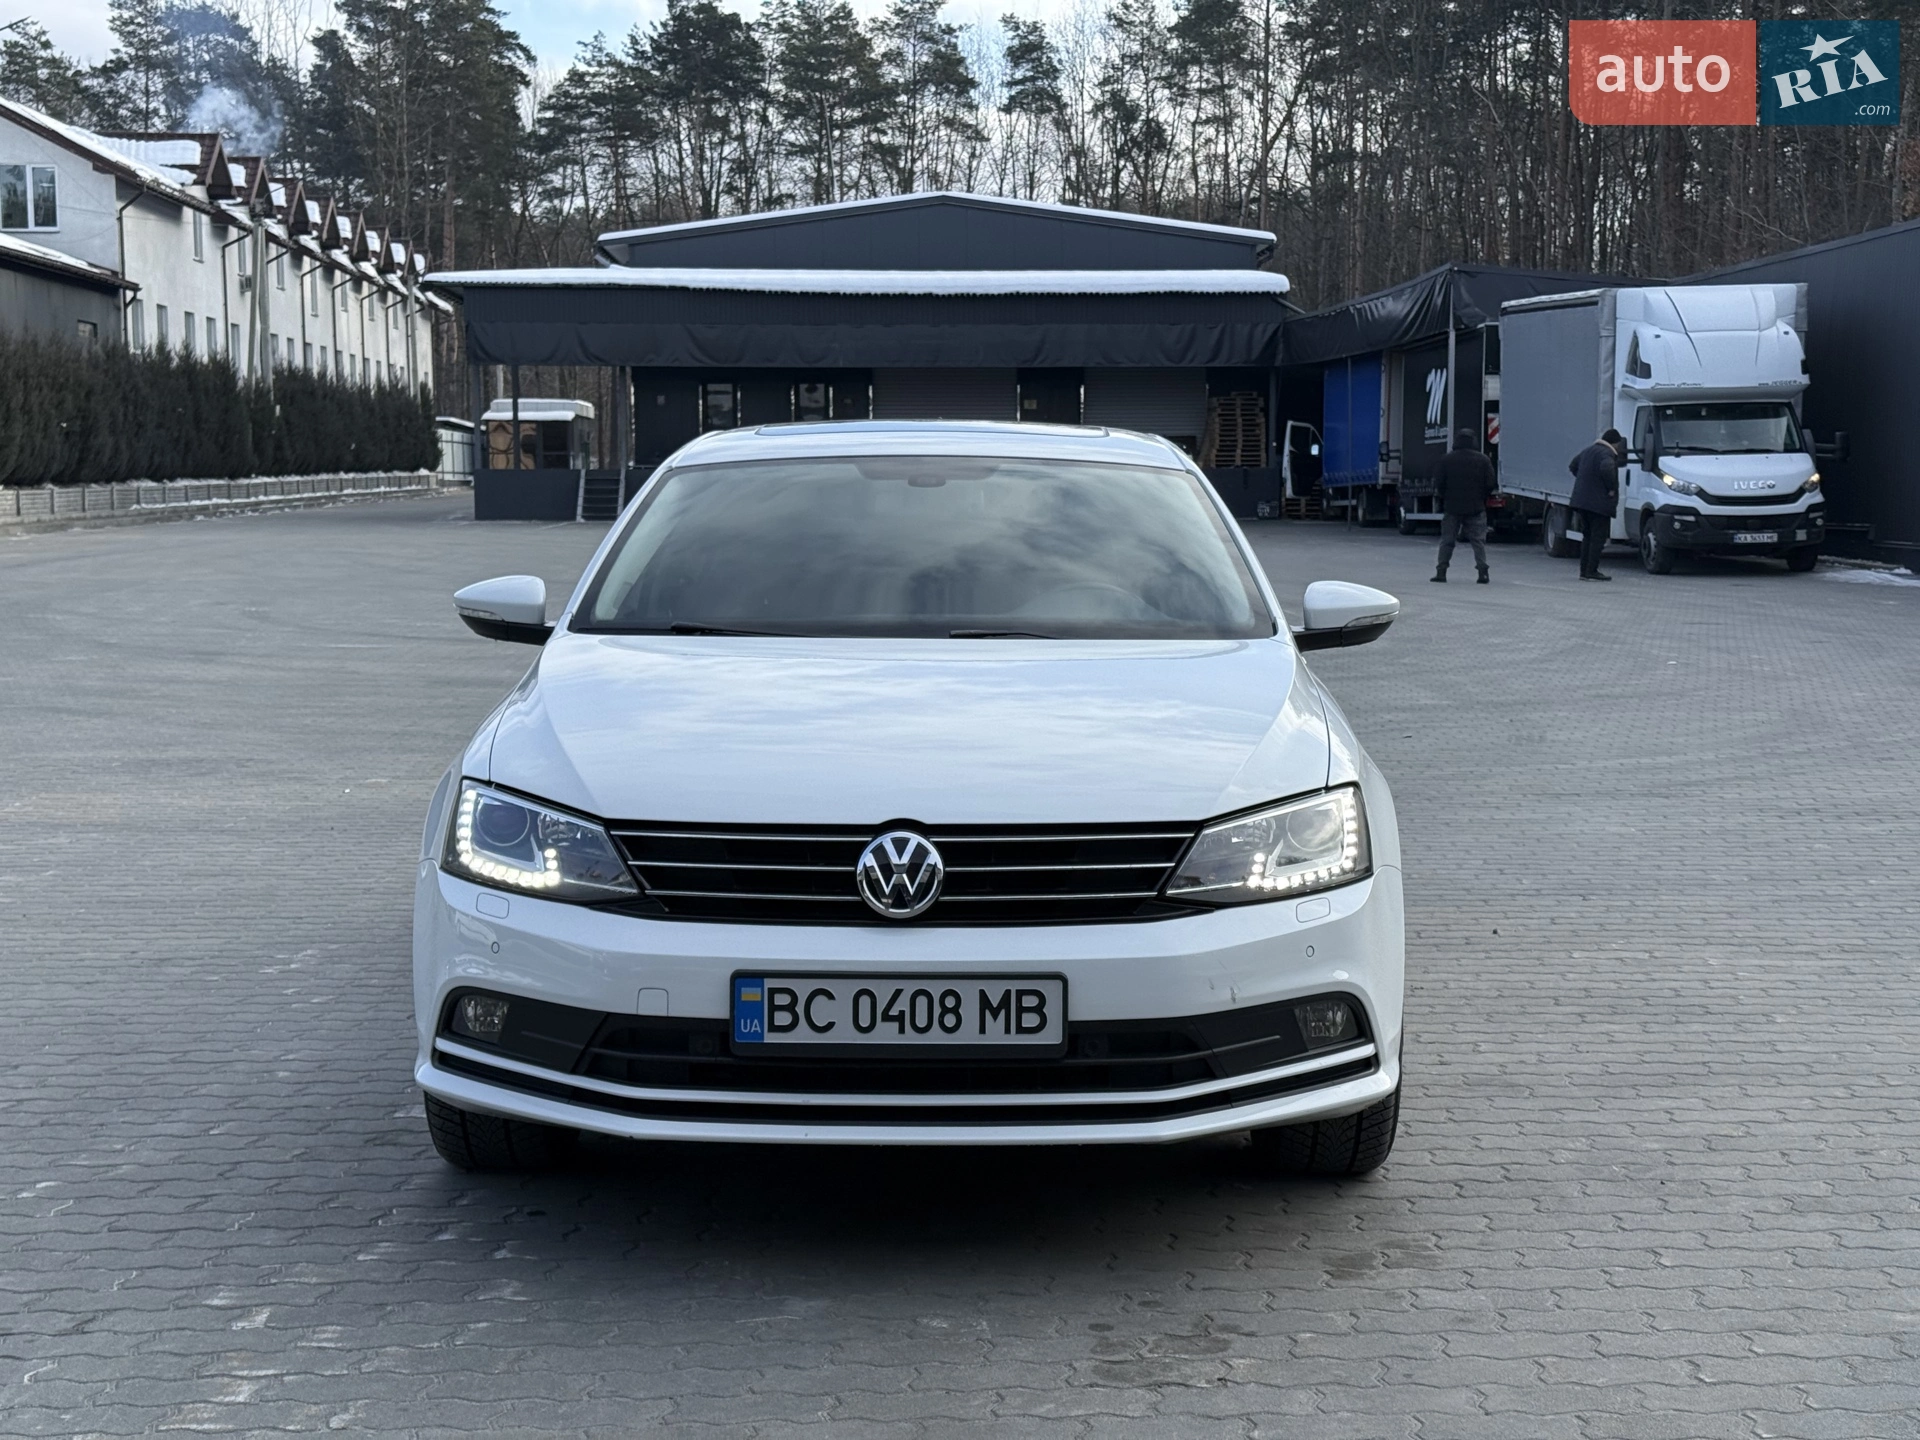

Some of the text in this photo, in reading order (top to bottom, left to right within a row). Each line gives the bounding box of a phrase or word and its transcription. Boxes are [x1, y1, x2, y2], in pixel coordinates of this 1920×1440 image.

[1733, 480, 1776, 490] IVECO
[767, 987, 1047, 1035] BC 0408 MB
[740, 1019, 761, 1033] UA
